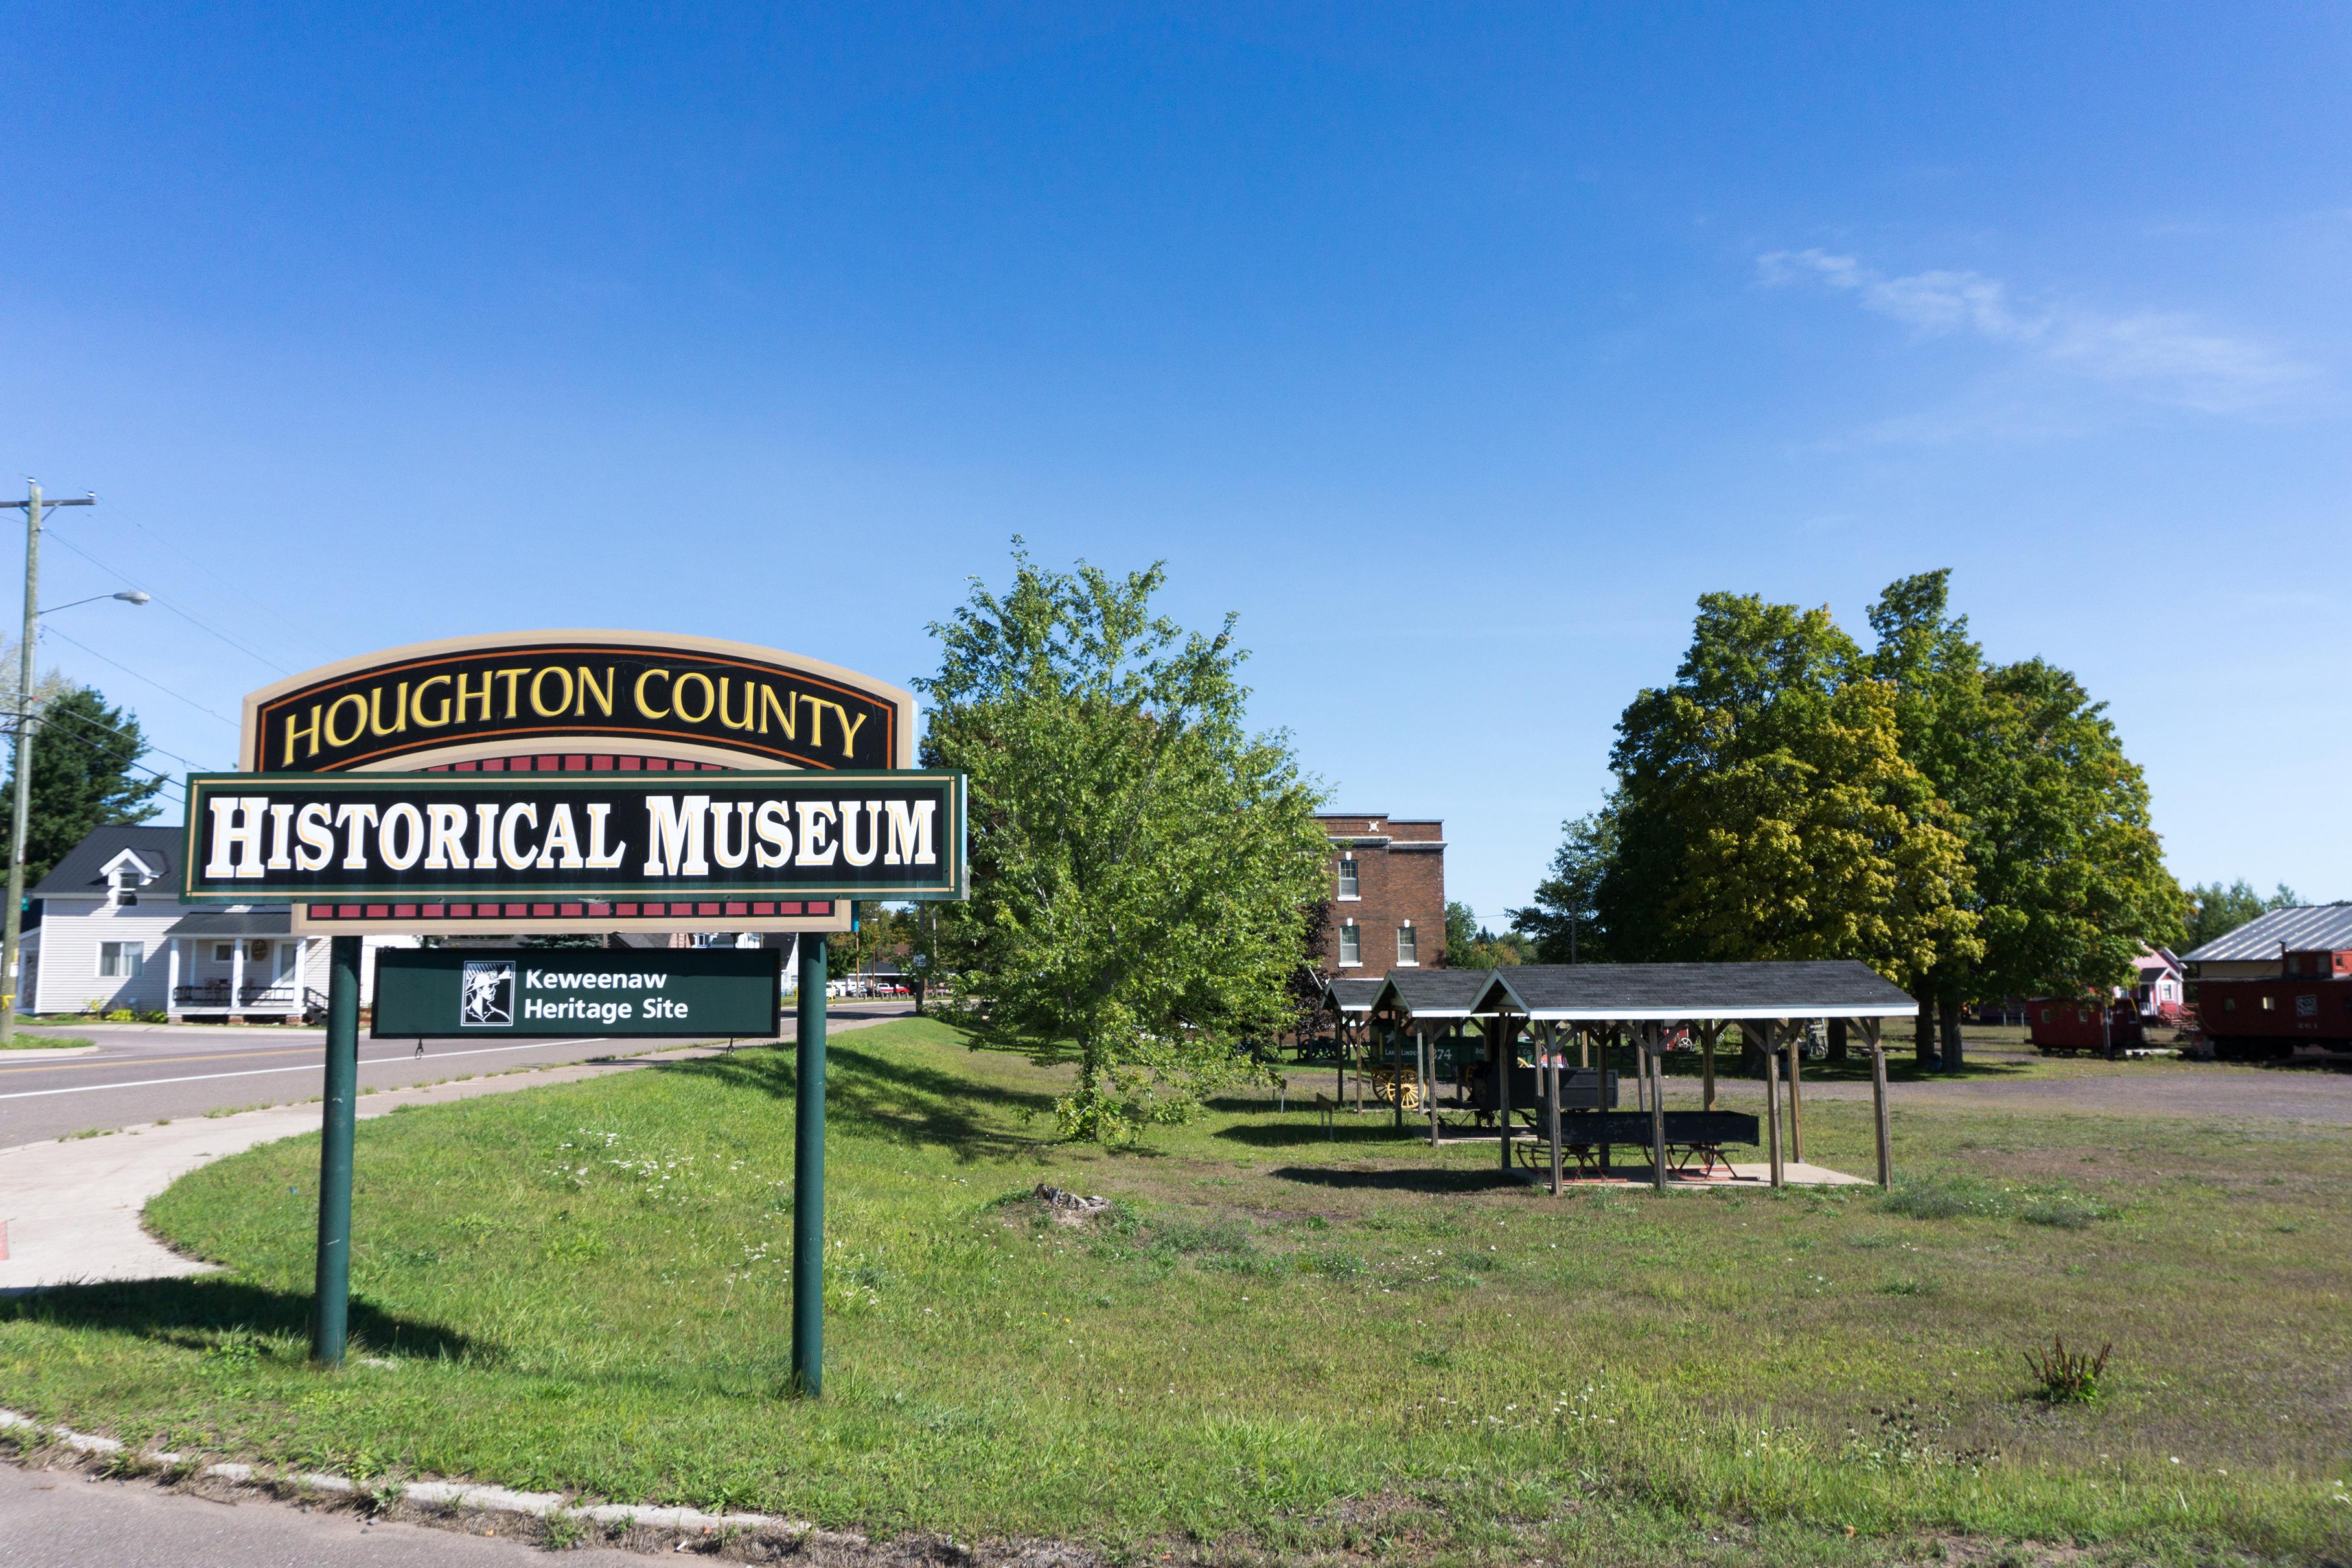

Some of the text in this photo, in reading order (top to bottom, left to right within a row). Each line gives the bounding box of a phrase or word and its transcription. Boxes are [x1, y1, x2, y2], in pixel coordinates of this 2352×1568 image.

[282, 665, 868, 765] HOUGHTON COUNTY
[205, 795, 936, 879] HISTORICAL MUSEUM
[525, 969, 667, 989] Keweenaw
[524, 998, 688, 1024] Heritage Site
